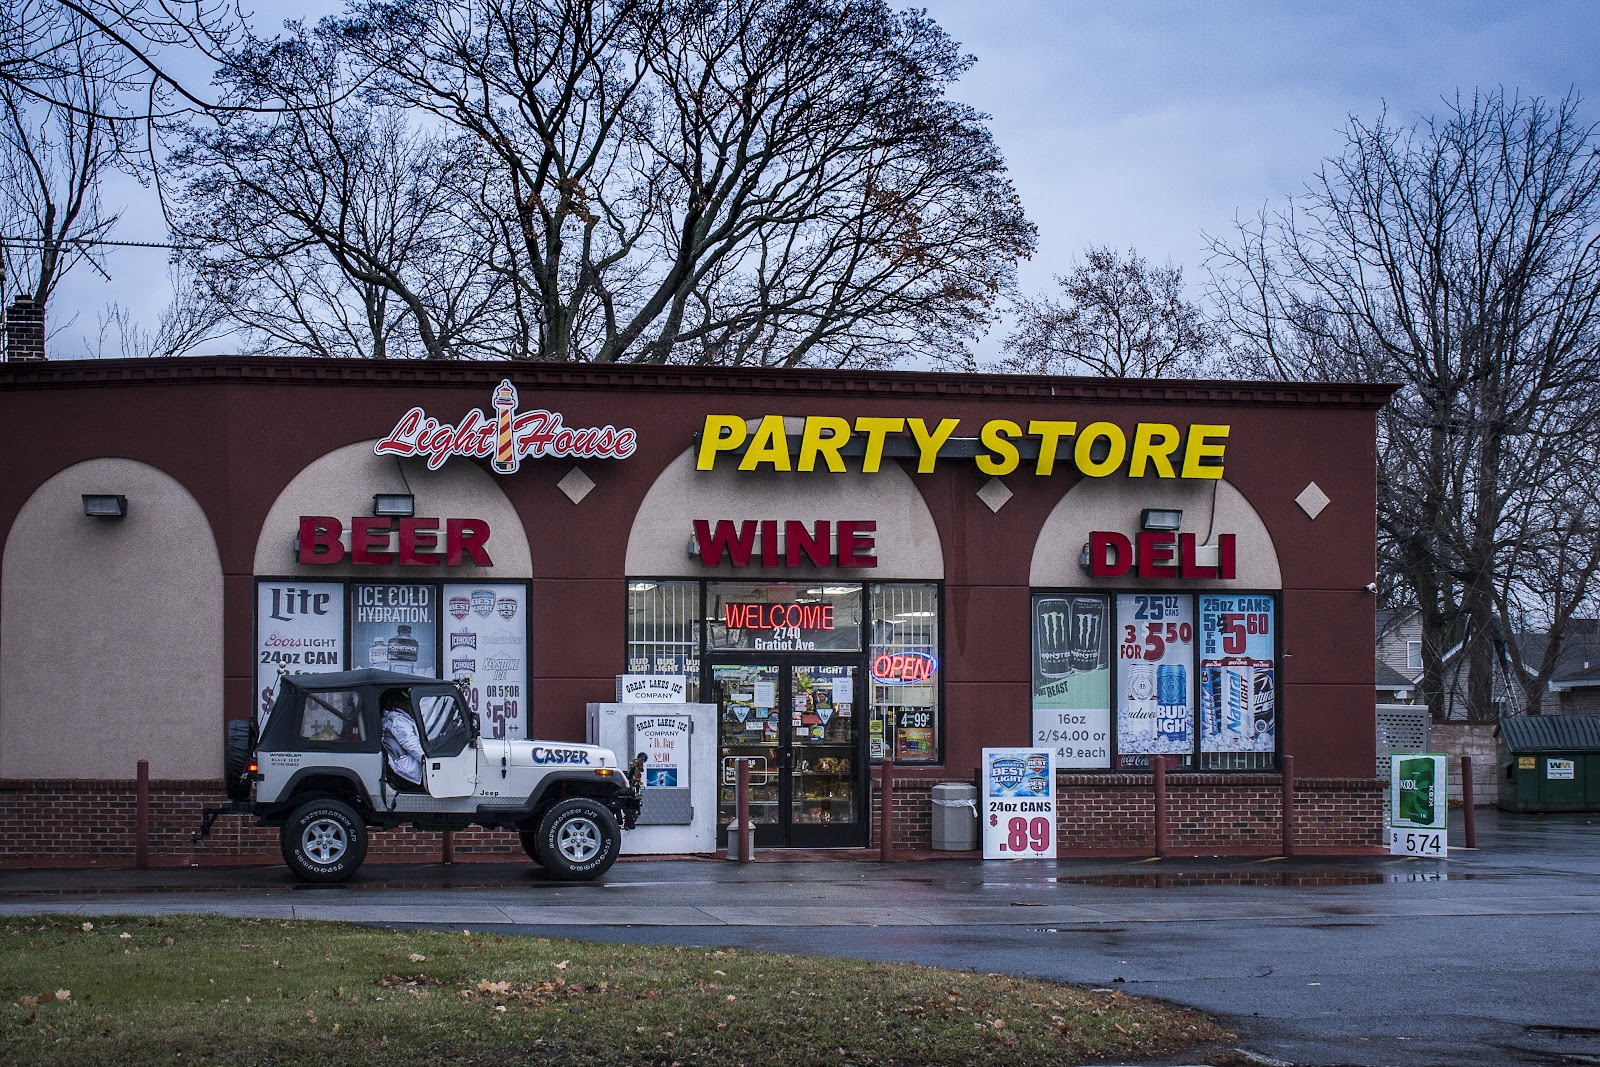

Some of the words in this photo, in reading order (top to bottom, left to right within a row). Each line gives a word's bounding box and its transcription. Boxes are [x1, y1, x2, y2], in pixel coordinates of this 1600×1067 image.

[375, 408, 497, 470] Light
[513, 410, 637, 459] House
[696, 414, 961, 474] PARTY
[975, 419, 1231, 479] STORE
[297, 515, 494, 568] BEER
[693, 519, 878, 568] WINE
[1089, 531, 1237, 580] DELI
[358, 586, 384, 606] ICE
[388, 586, 429, 607] COLD
[268, 587, 331, 622] Lite
[449, 603, 470, 611] BEST
[498, 603, 517, 611] BEST
[1135, 596, 1164, 620] 25
[1165, 596, 1179, 608] OZ
[1204, 598, 1234, 612] 25oz
[1238, 598, 1271, 612] CANS
[725, 603, 836, 630] WELCOME
[1204, 614, 1216, 632] 5
[264, 633, 303, 647] Coors
[303, 638, 337, 647] LIGHT
[773, 627, 801, 640] 2740
[1124, 624, 1137, 644] 3
[452, 635, 476, 647] ICEHOUSE
[754, 638, 792, 650] Gratiot
[305, 651, 338, 665] CAN
[1121, 644, 1142, 659] FOR
[453, 661, 475, 672] ICEHOUSE
[482, 658, 520, 671] KEYSTONE
[819, 666, 843, 674] LIGHT
[873, 655, 932, 681] OPEN
[493, 669, 508, 680] ICE
[486, 685, 497, 697] OR
[498, 685, 504, 697] 5
[505, 685, 520, 697] FOR
[625, 680, 647, 693] GREAT
[650, 679, 670, 690] LAKES
[671, 682, 683, 694] ICE
[1047, 681, 1069, 698] BEAST
[1241, 675, 1249, 711] LIGHT
[1158, 705, 1186, 718] BUD
[636, 719, 655, 731] GREAT
[657, 718, 676, 728] LAKES
[677, 720, 688, 732] ICE
[1057, 713, 1086, 725] 16oz
[1157, 719, 1186, 733] IGH
[1038, 729, 1089, 742] 2/$4.00
[1093, 732, 1106, 741] or
[531, 747, 591, 765] CASPER
[1077, 746, 1106, 758] each
[992, 767, 1025, 777] BEST
[479, 789, 499, 797] Jeep
[989, 801, 1018, 813] 24oz
[1020, 801, 1052, 812] CANS
[989, 813, 998, 827] $
[999, 816, 1050, 852] .89
[1393, 832, 1398, 843] $
